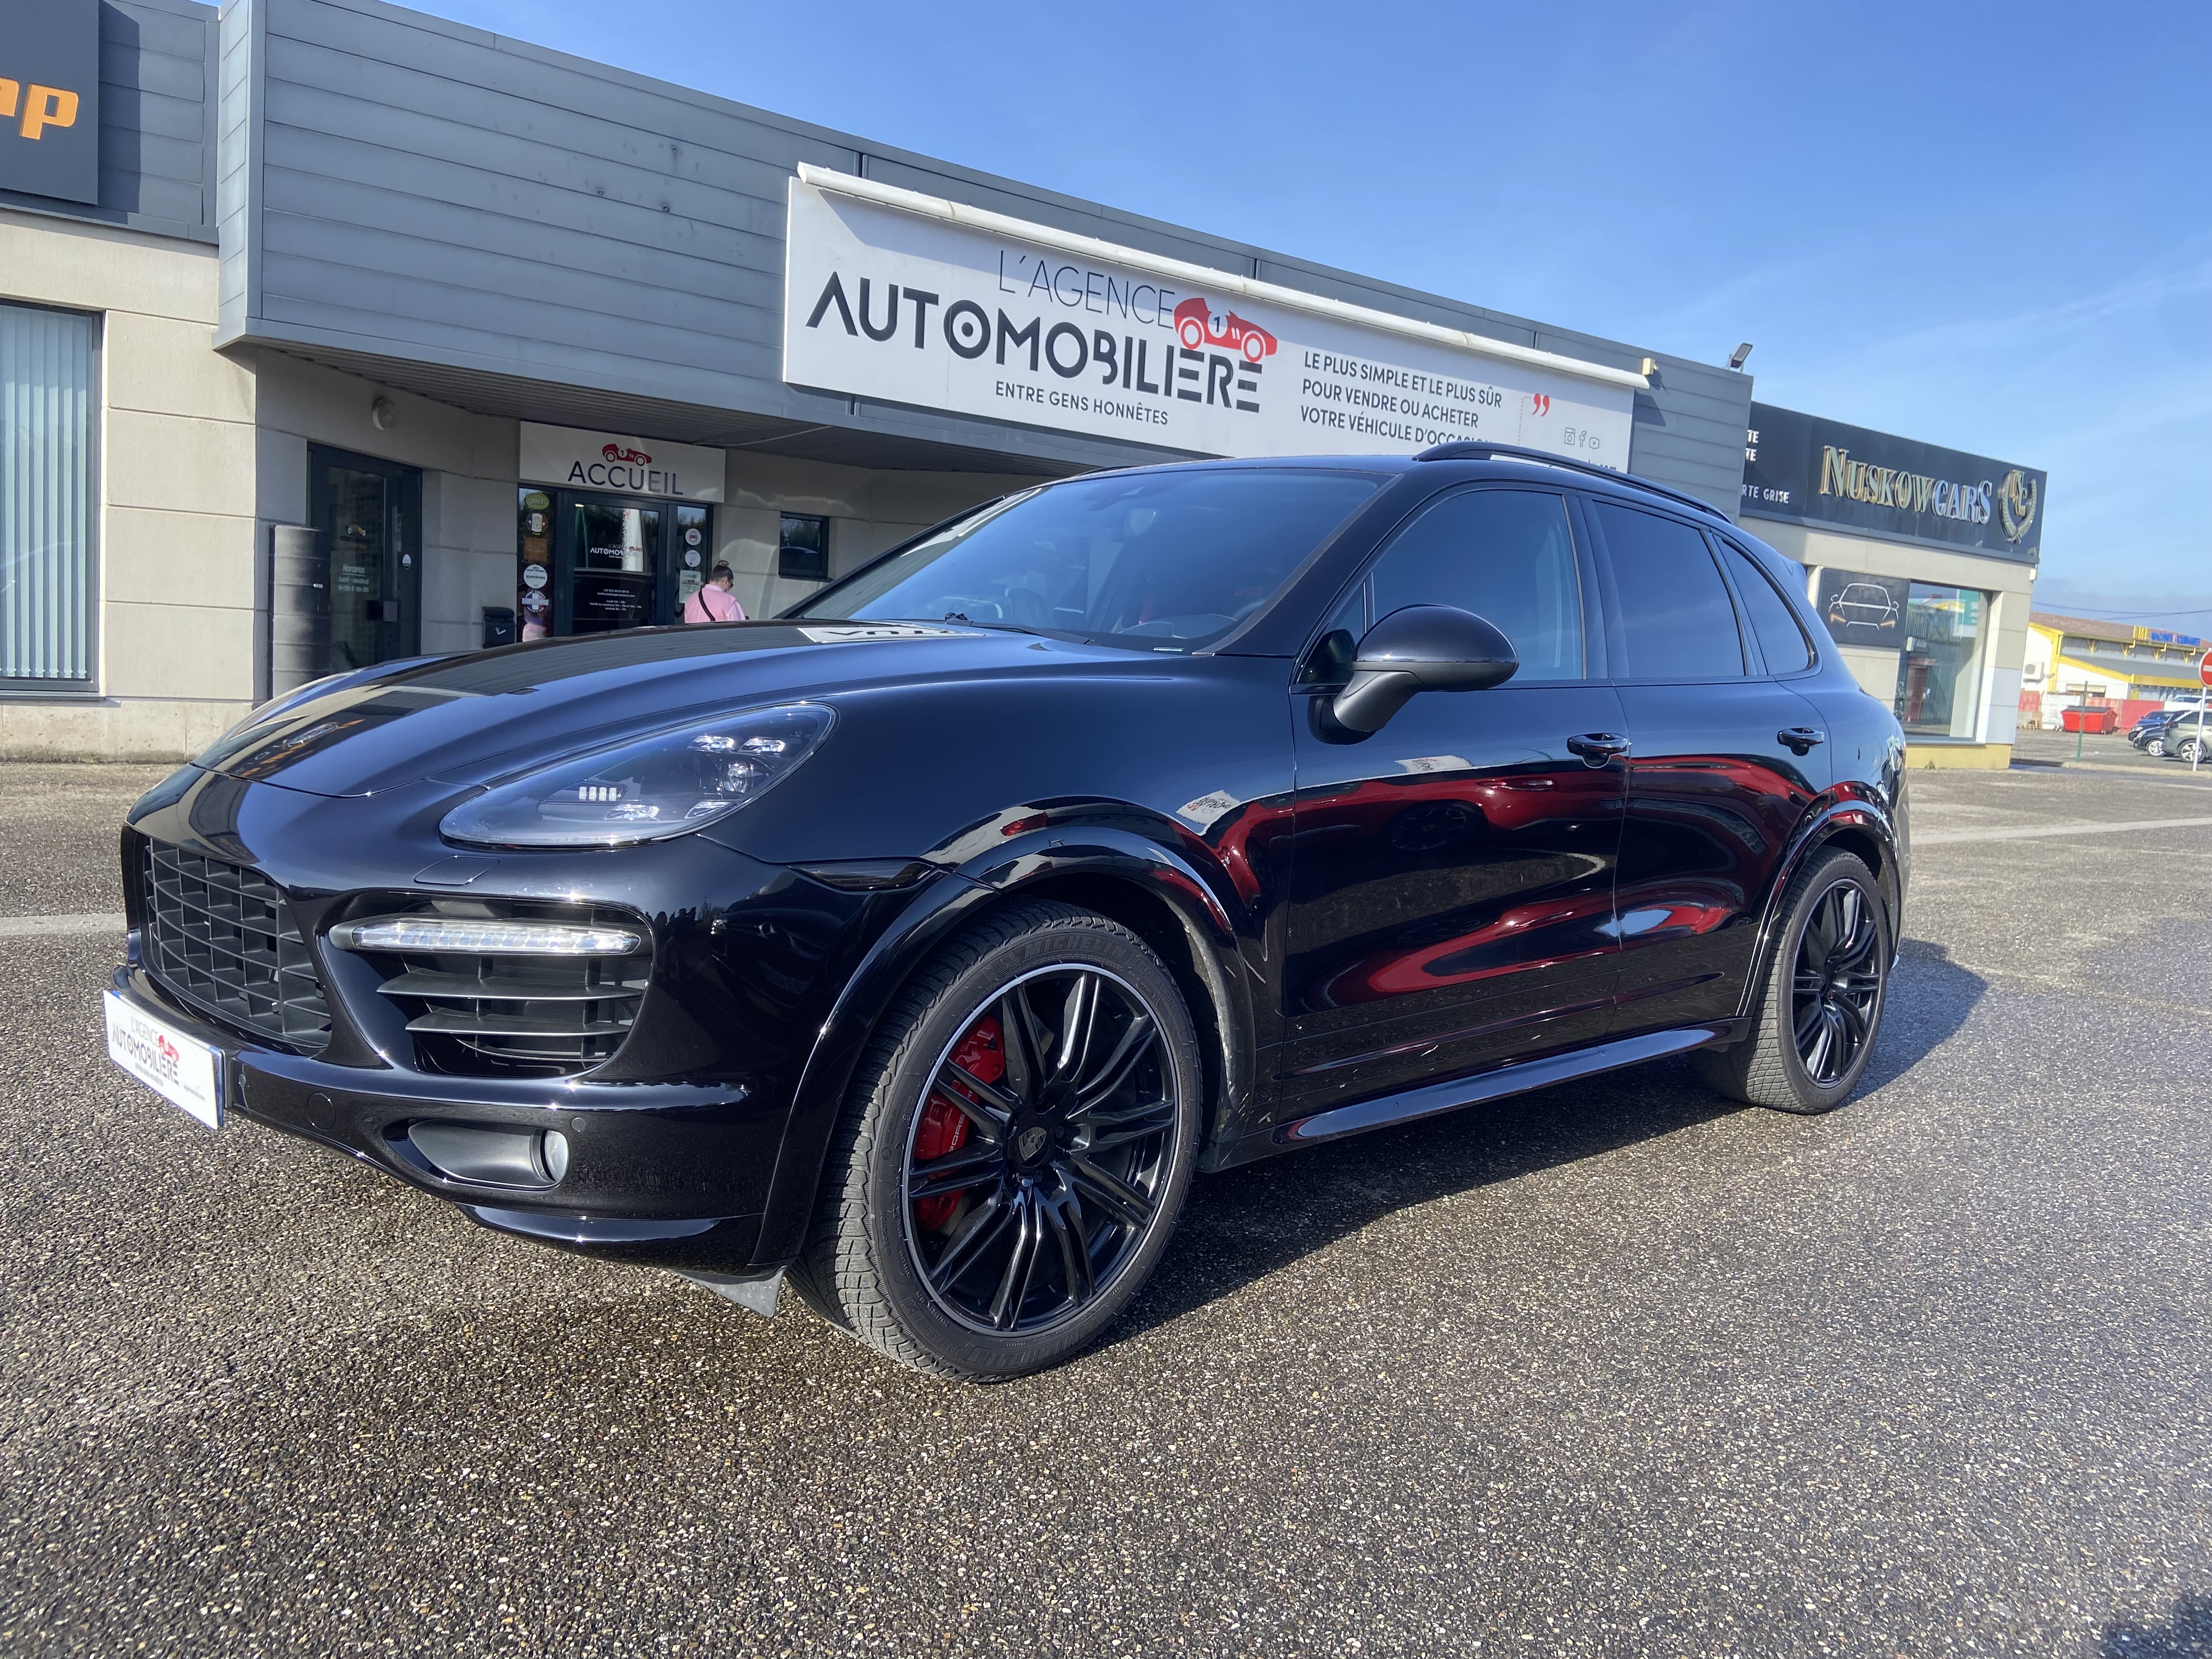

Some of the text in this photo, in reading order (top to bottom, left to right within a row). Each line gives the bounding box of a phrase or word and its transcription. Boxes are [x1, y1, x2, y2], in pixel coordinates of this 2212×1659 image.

[998, 250, 1176, 330] L'AGENCE
[1304, 351, 1502, 409] LE PLUS SIMPLE ET LE PLUS SÛR
[995, 381, 1168, 426] ENTRE GENS HONNÊTES
[1302, 378, 1479, 428] POUR VENDRE OU ACHETER
[1300, 404, 1346, 430] VOTRE
[1348, 411, 1412, 441] VÉHICULE
[567, 460, 684, 495] ACCUEIL
[1763, 488, 1790, 504] GRISE
[1025, 936, 1128, 960] MICHELIN
[1136, 960, 1157, 980] PILOT
[1158, 982, 1176, 1008] ALPIN
[131, 1016, 160, 1048] L'AGENCE
